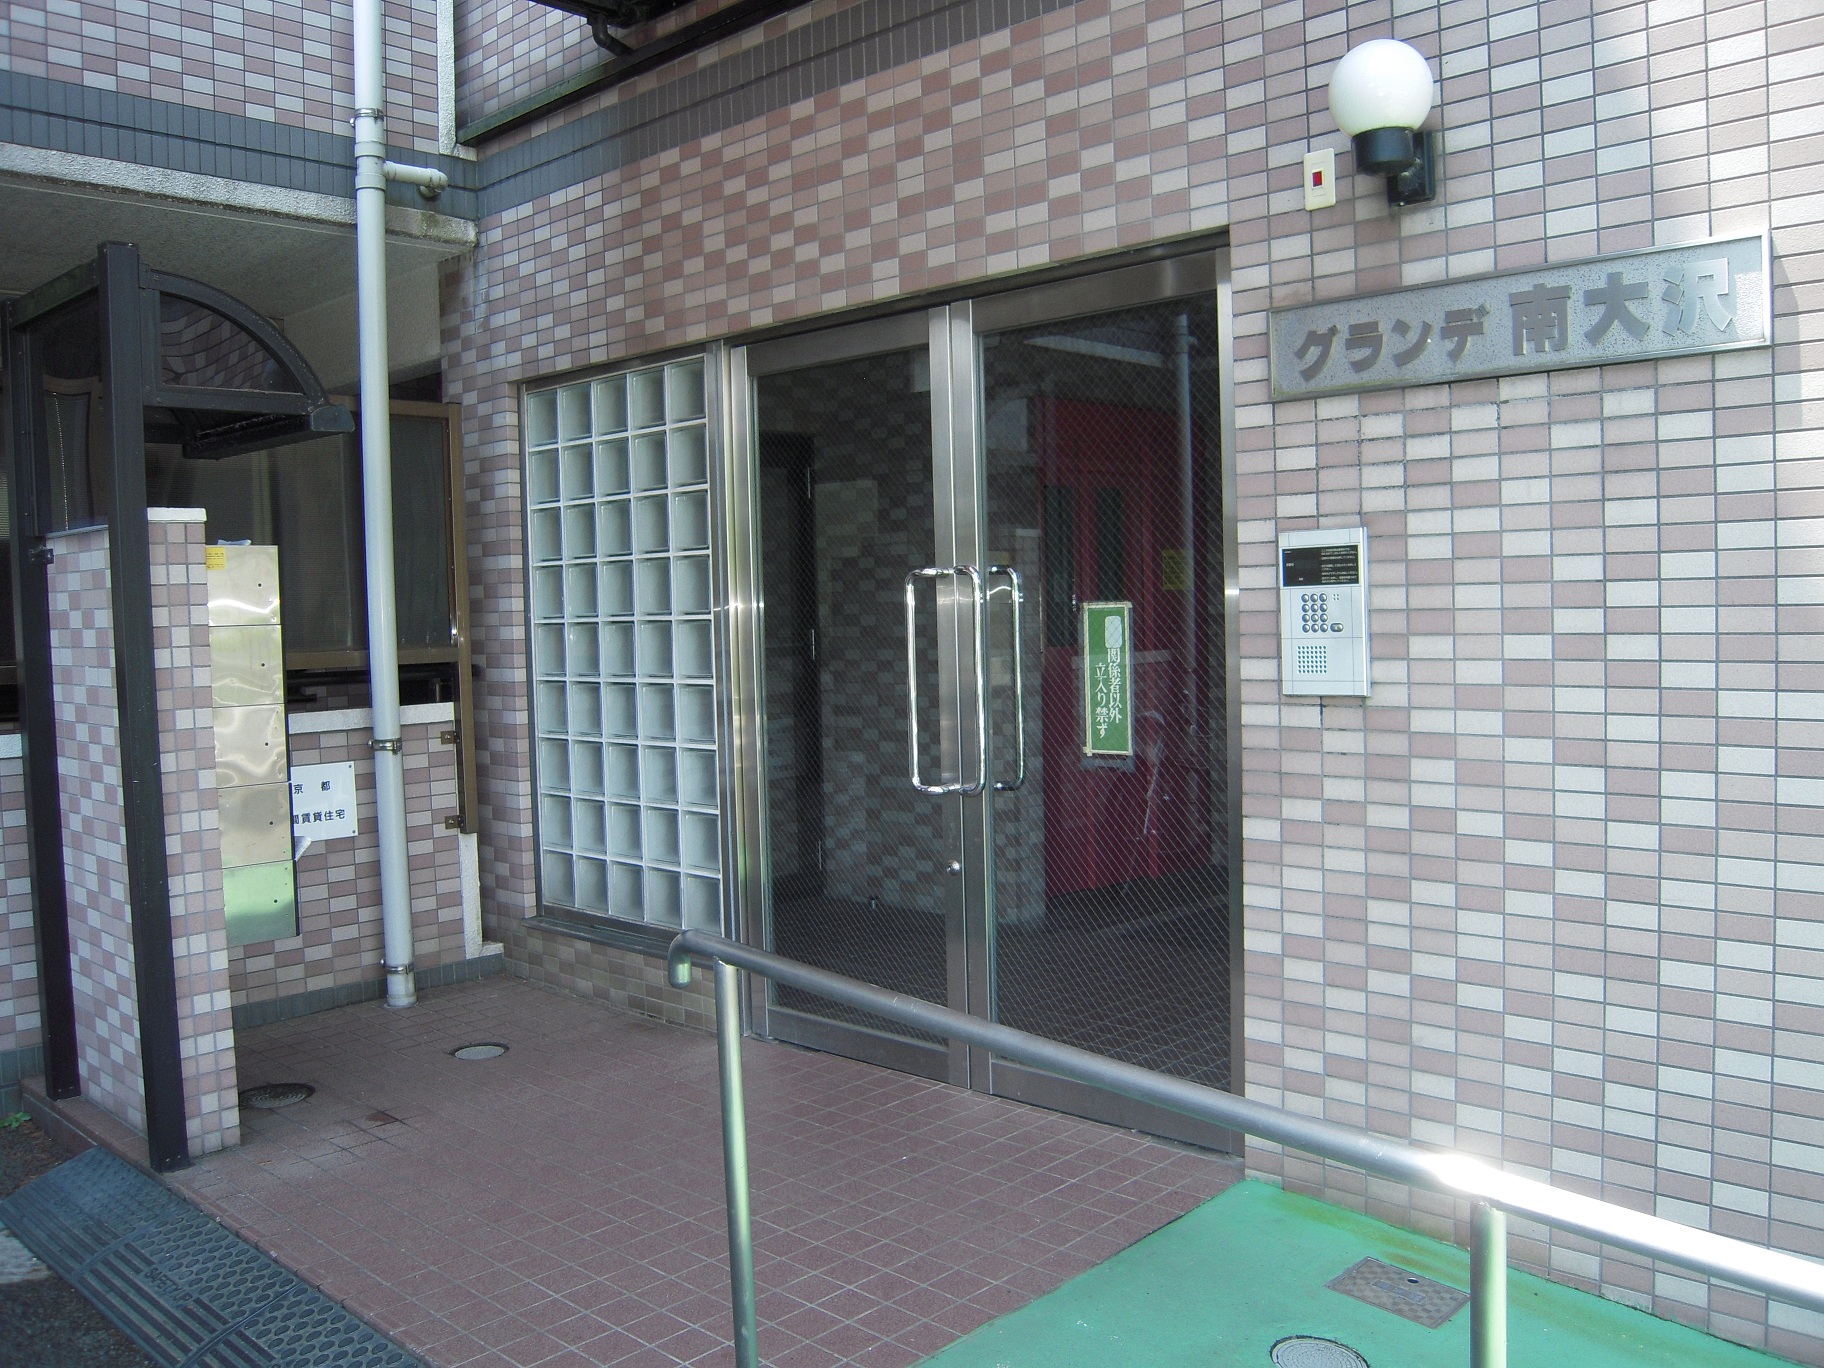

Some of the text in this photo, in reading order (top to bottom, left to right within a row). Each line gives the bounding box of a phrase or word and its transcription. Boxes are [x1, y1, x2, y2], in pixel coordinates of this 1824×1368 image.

[1295, 258, 1732, 381] グランデ南大沢
[1095, 663, 1108, 739] 立入り禁ず
[1107, 649, 1122, 723] 関係者以外
